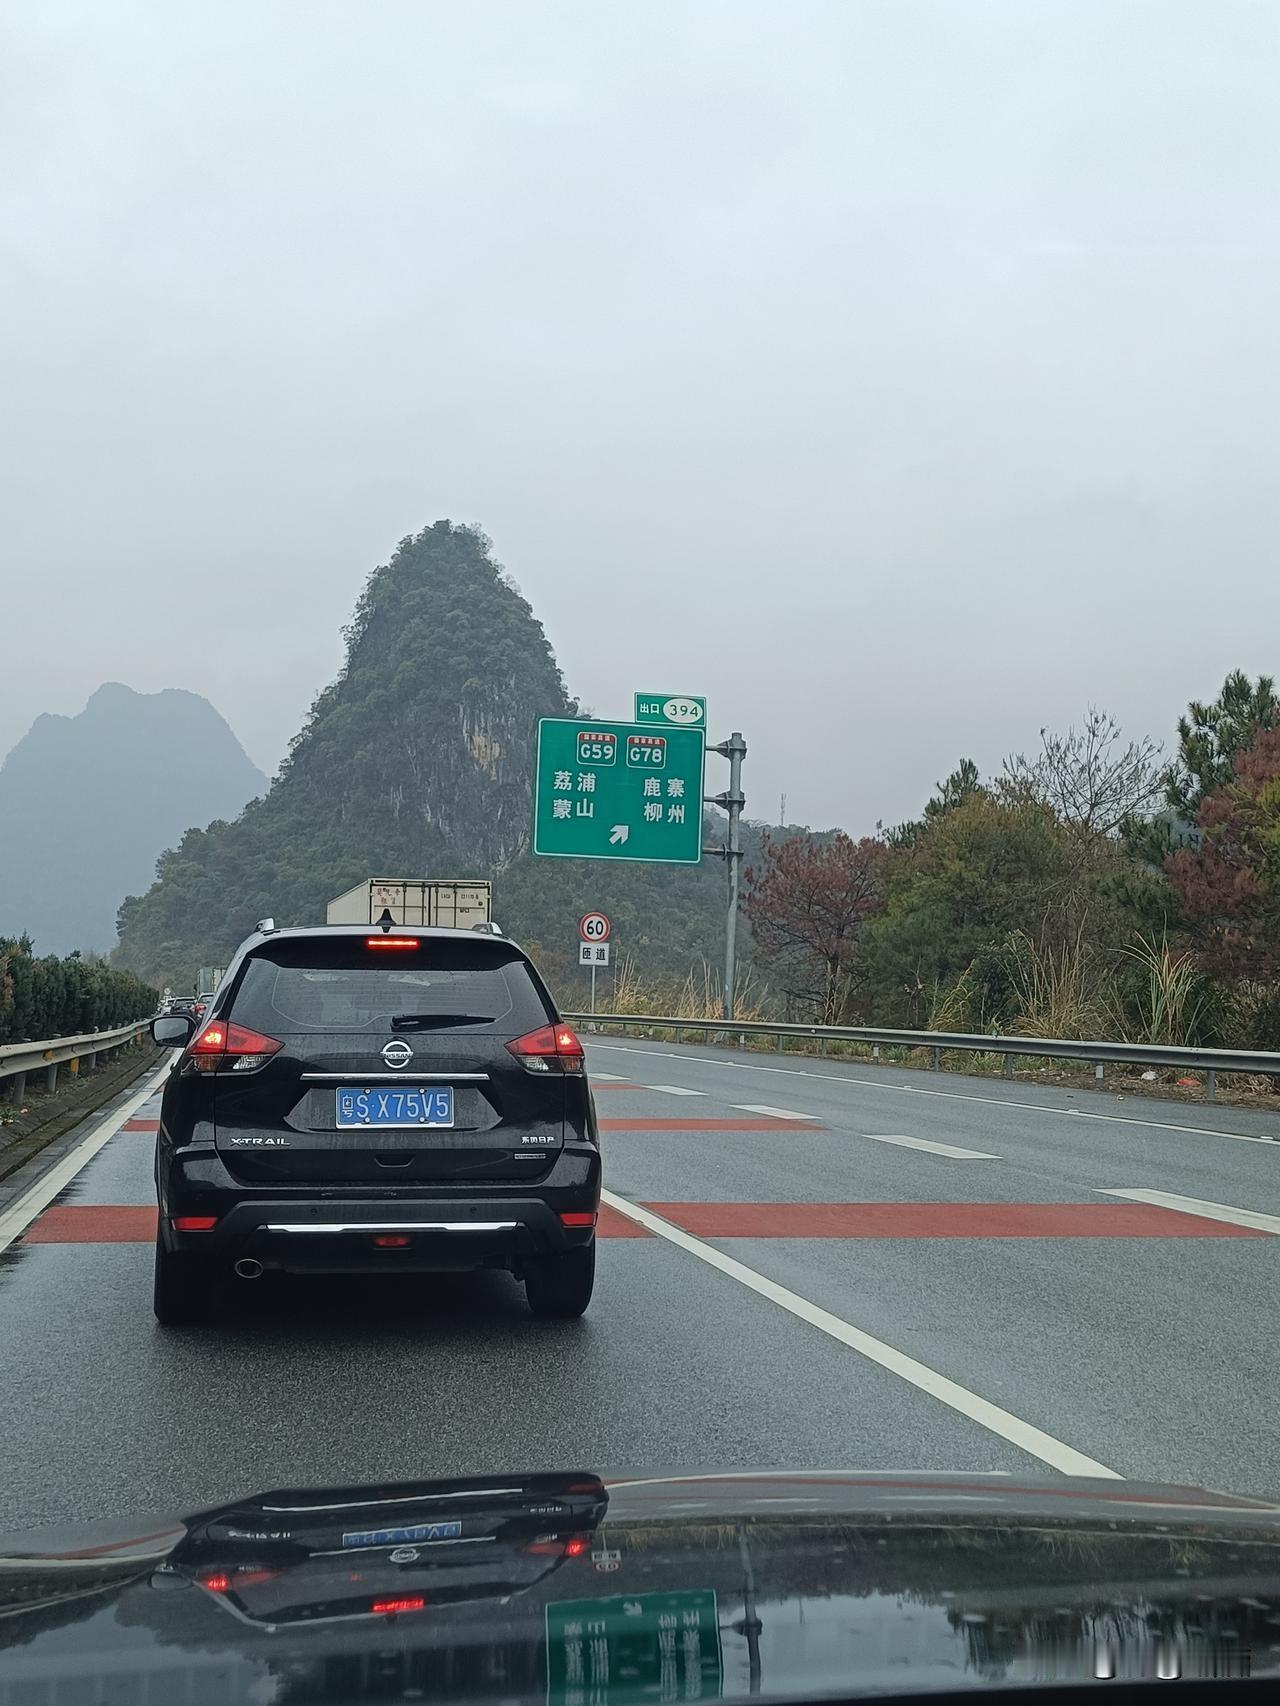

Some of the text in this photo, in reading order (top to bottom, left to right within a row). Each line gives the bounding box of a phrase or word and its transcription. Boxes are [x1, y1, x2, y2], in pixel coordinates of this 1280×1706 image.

[640, 703, 699, 717] 出口 394
[580, 743, 613, 760] G59
[630, 747, 662, 763] G78
[553, 770, 597, 793] 荔浦
[643, 777, 685, 798] 鹿寨
[552, 798, 594, 819] 蒙山
[643, 802, 685, 824] 柳州
[587, 920, 603, 935] 60
[582, 947, 605, 960] 匝道
